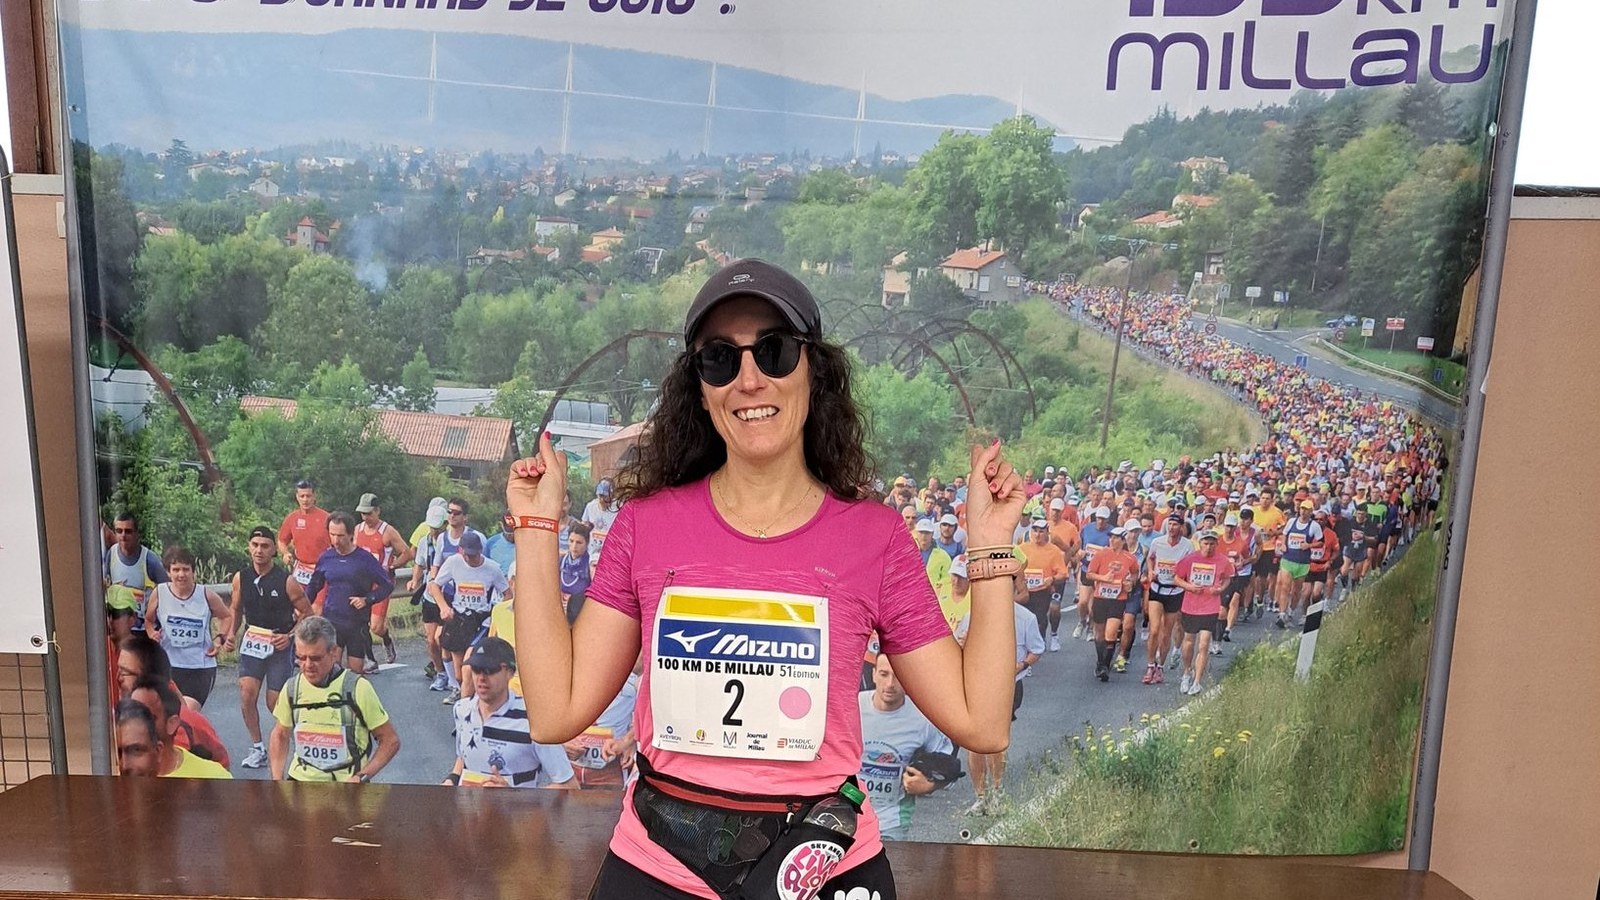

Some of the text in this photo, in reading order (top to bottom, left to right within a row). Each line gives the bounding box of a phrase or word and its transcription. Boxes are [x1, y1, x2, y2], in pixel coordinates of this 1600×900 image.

[172, 628, 199, 638] 5243
[246, 640, 268, 653] 841
[657, 657, 679, 671] 100
[682, 659, 701, 673] KM
[705, 661, 722, 674] DE
[724, 662, 775, 677] MILLAU
[722, 679, 745, 727] 2
[303, 746, 338, 760] 2085
[864, 780, 893, 793] 046
